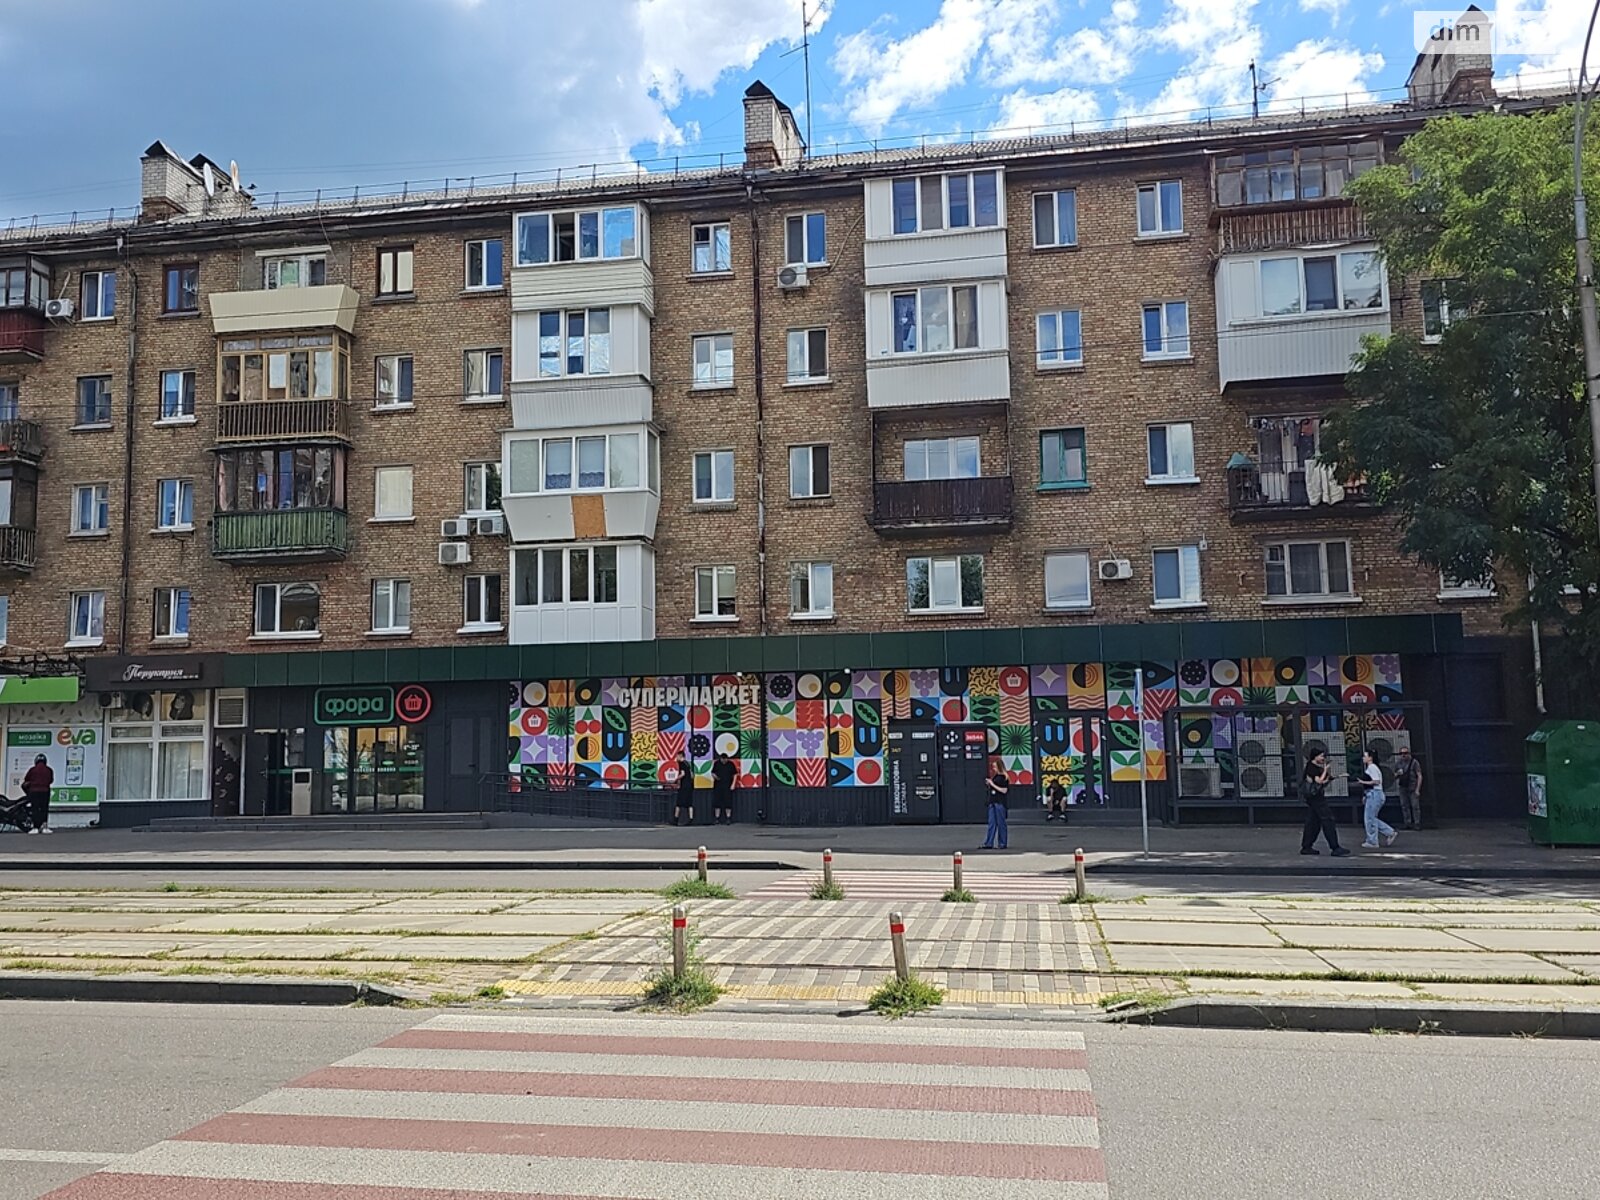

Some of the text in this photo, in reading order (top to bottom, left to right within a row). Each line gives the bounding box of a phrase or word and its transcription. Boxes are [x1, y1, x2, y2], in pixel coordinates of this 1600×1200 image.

[122, 664, 184, 681] Перукарня
[618, 684, 760, 708] СУПЕРМАРКЕТ
[56, 727, 96, 746] eva
